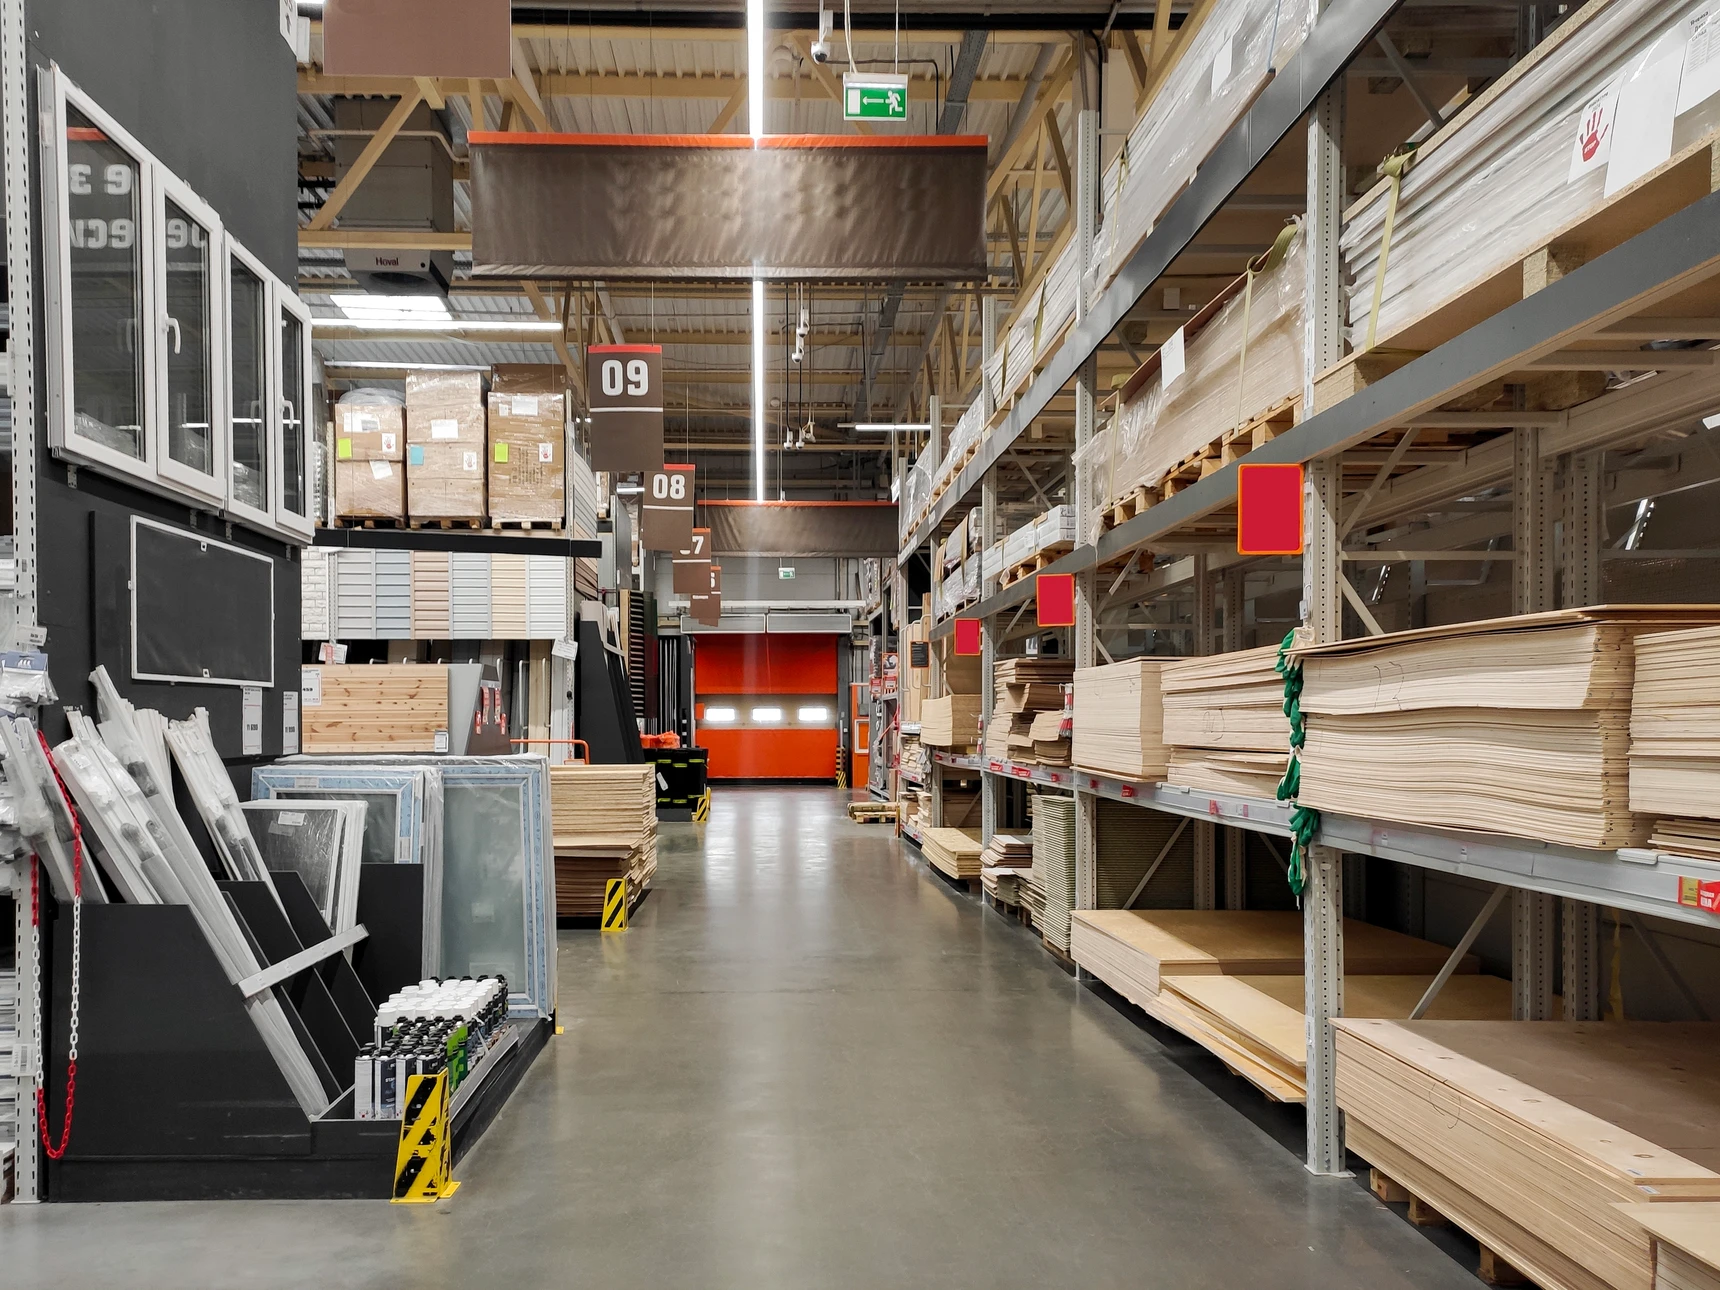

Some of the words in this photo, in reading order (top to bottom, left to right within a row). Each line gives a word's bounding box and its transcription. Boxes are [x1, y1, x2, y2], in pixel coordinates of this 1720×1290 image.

[375, 256, 399, 265] Hoval
[601, 359, 649, 397] 09
[652, 473, 686, 500] 08
[679, 535, 704, 555] 7
